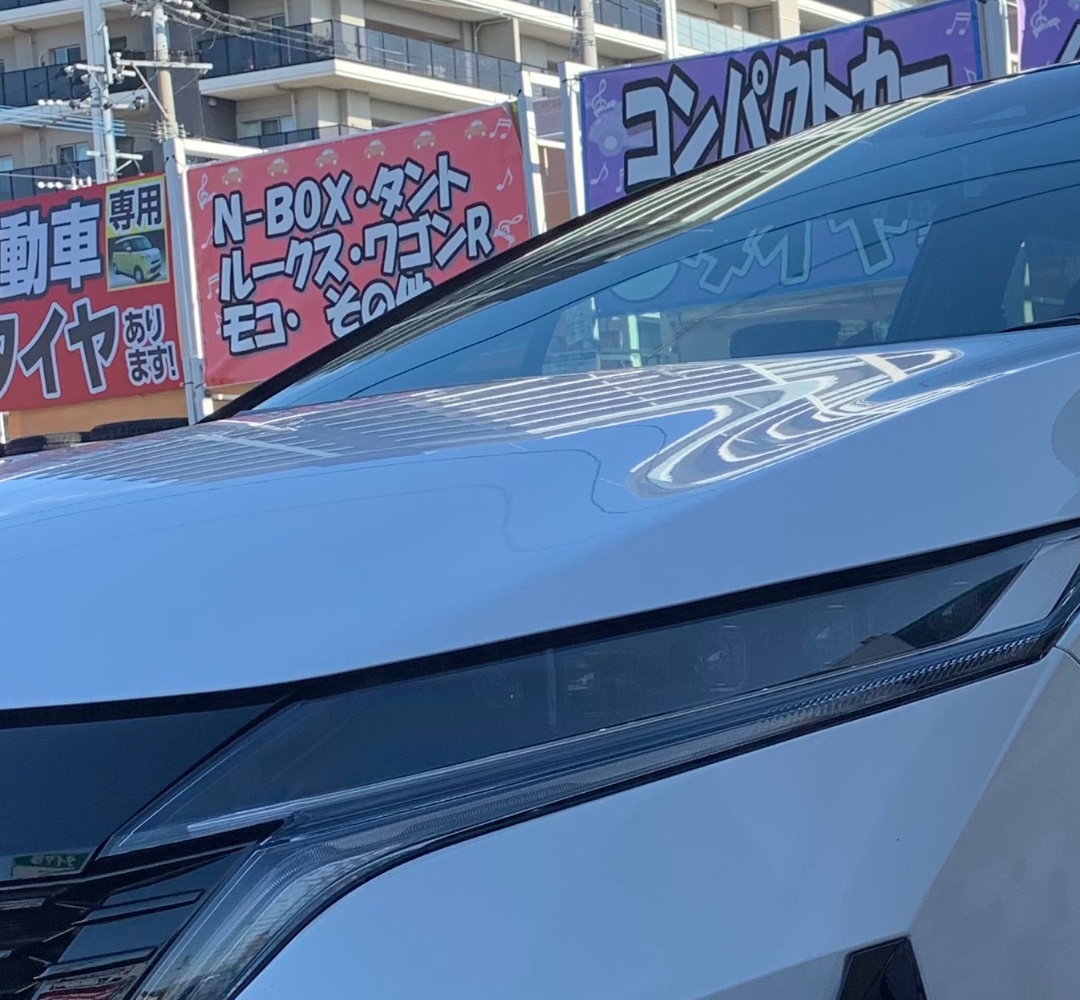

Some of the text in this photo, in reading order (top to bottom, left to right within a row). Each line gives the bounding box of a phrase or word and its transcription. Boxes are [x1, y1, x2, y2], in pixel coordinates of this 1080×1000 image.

[623, 26, 951, 192] コンパクトカー
[109, 183, 162, 232] 専用
[213, 152, 470, 246] N-BOX・タント
[219, 202, 493, 302] ルークス・ワゴンR
[123, 304, 165, 347] あり
[126, 341, 180, 387] ます!
